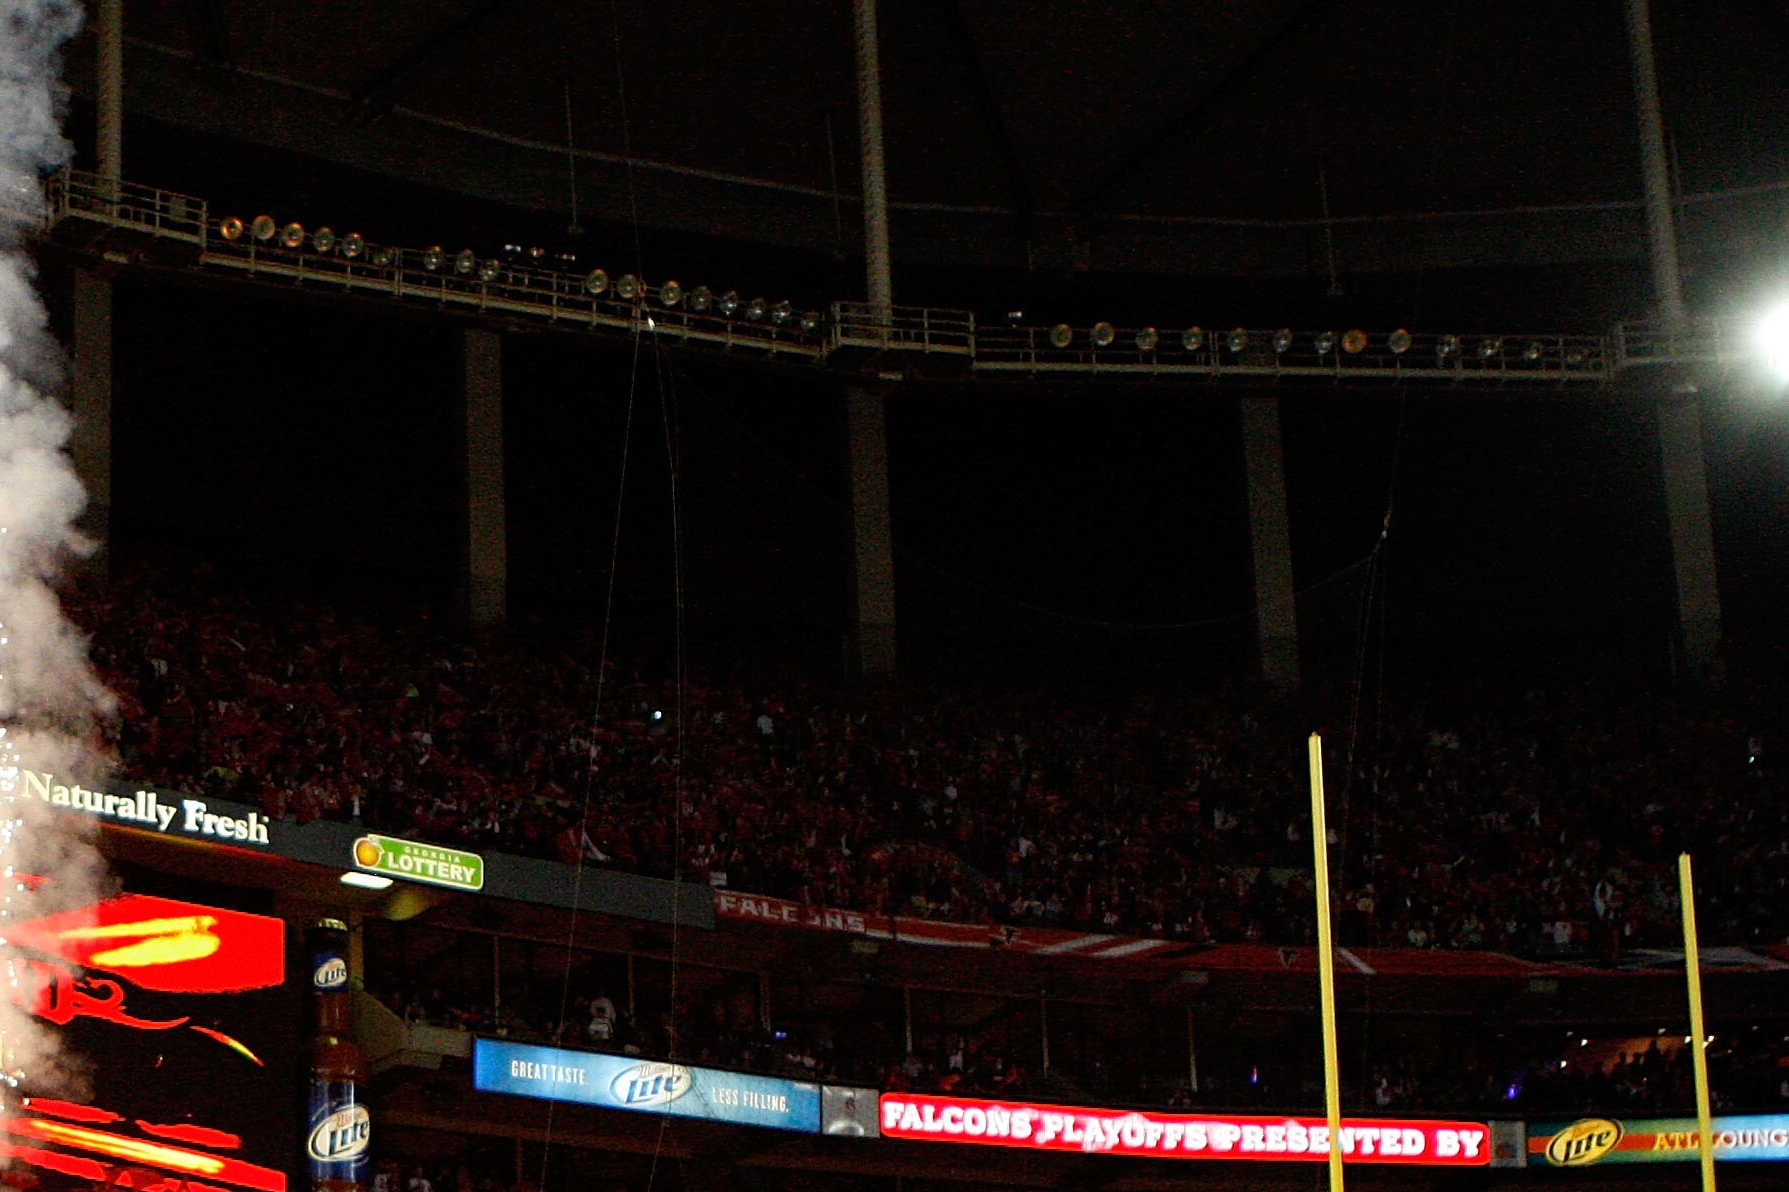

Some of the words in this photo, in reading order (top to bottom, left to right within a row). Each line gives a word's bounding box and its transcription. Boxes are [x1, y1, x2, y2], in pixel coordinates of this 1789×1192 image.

[22, 769, 177, 831] Naturally
[183, 799, 269, 844] Fresh
[388, 852, 475, 883] LOTTERY
[404, 846, 460, 863] GEORGIA
[511, 1059, 549, 1080] GREAT
[625, 1075, 682, 1104] Lite
[712, 1087, 740, 1106] LESS
[883, 1102, 1032, 1139] FALCONS
[1041, 1114, 1208, 1151] PLAYOFFS
[1436, 1129, 1484, 1157] BY
[1562, 1128, 1611, 1162] Lite
